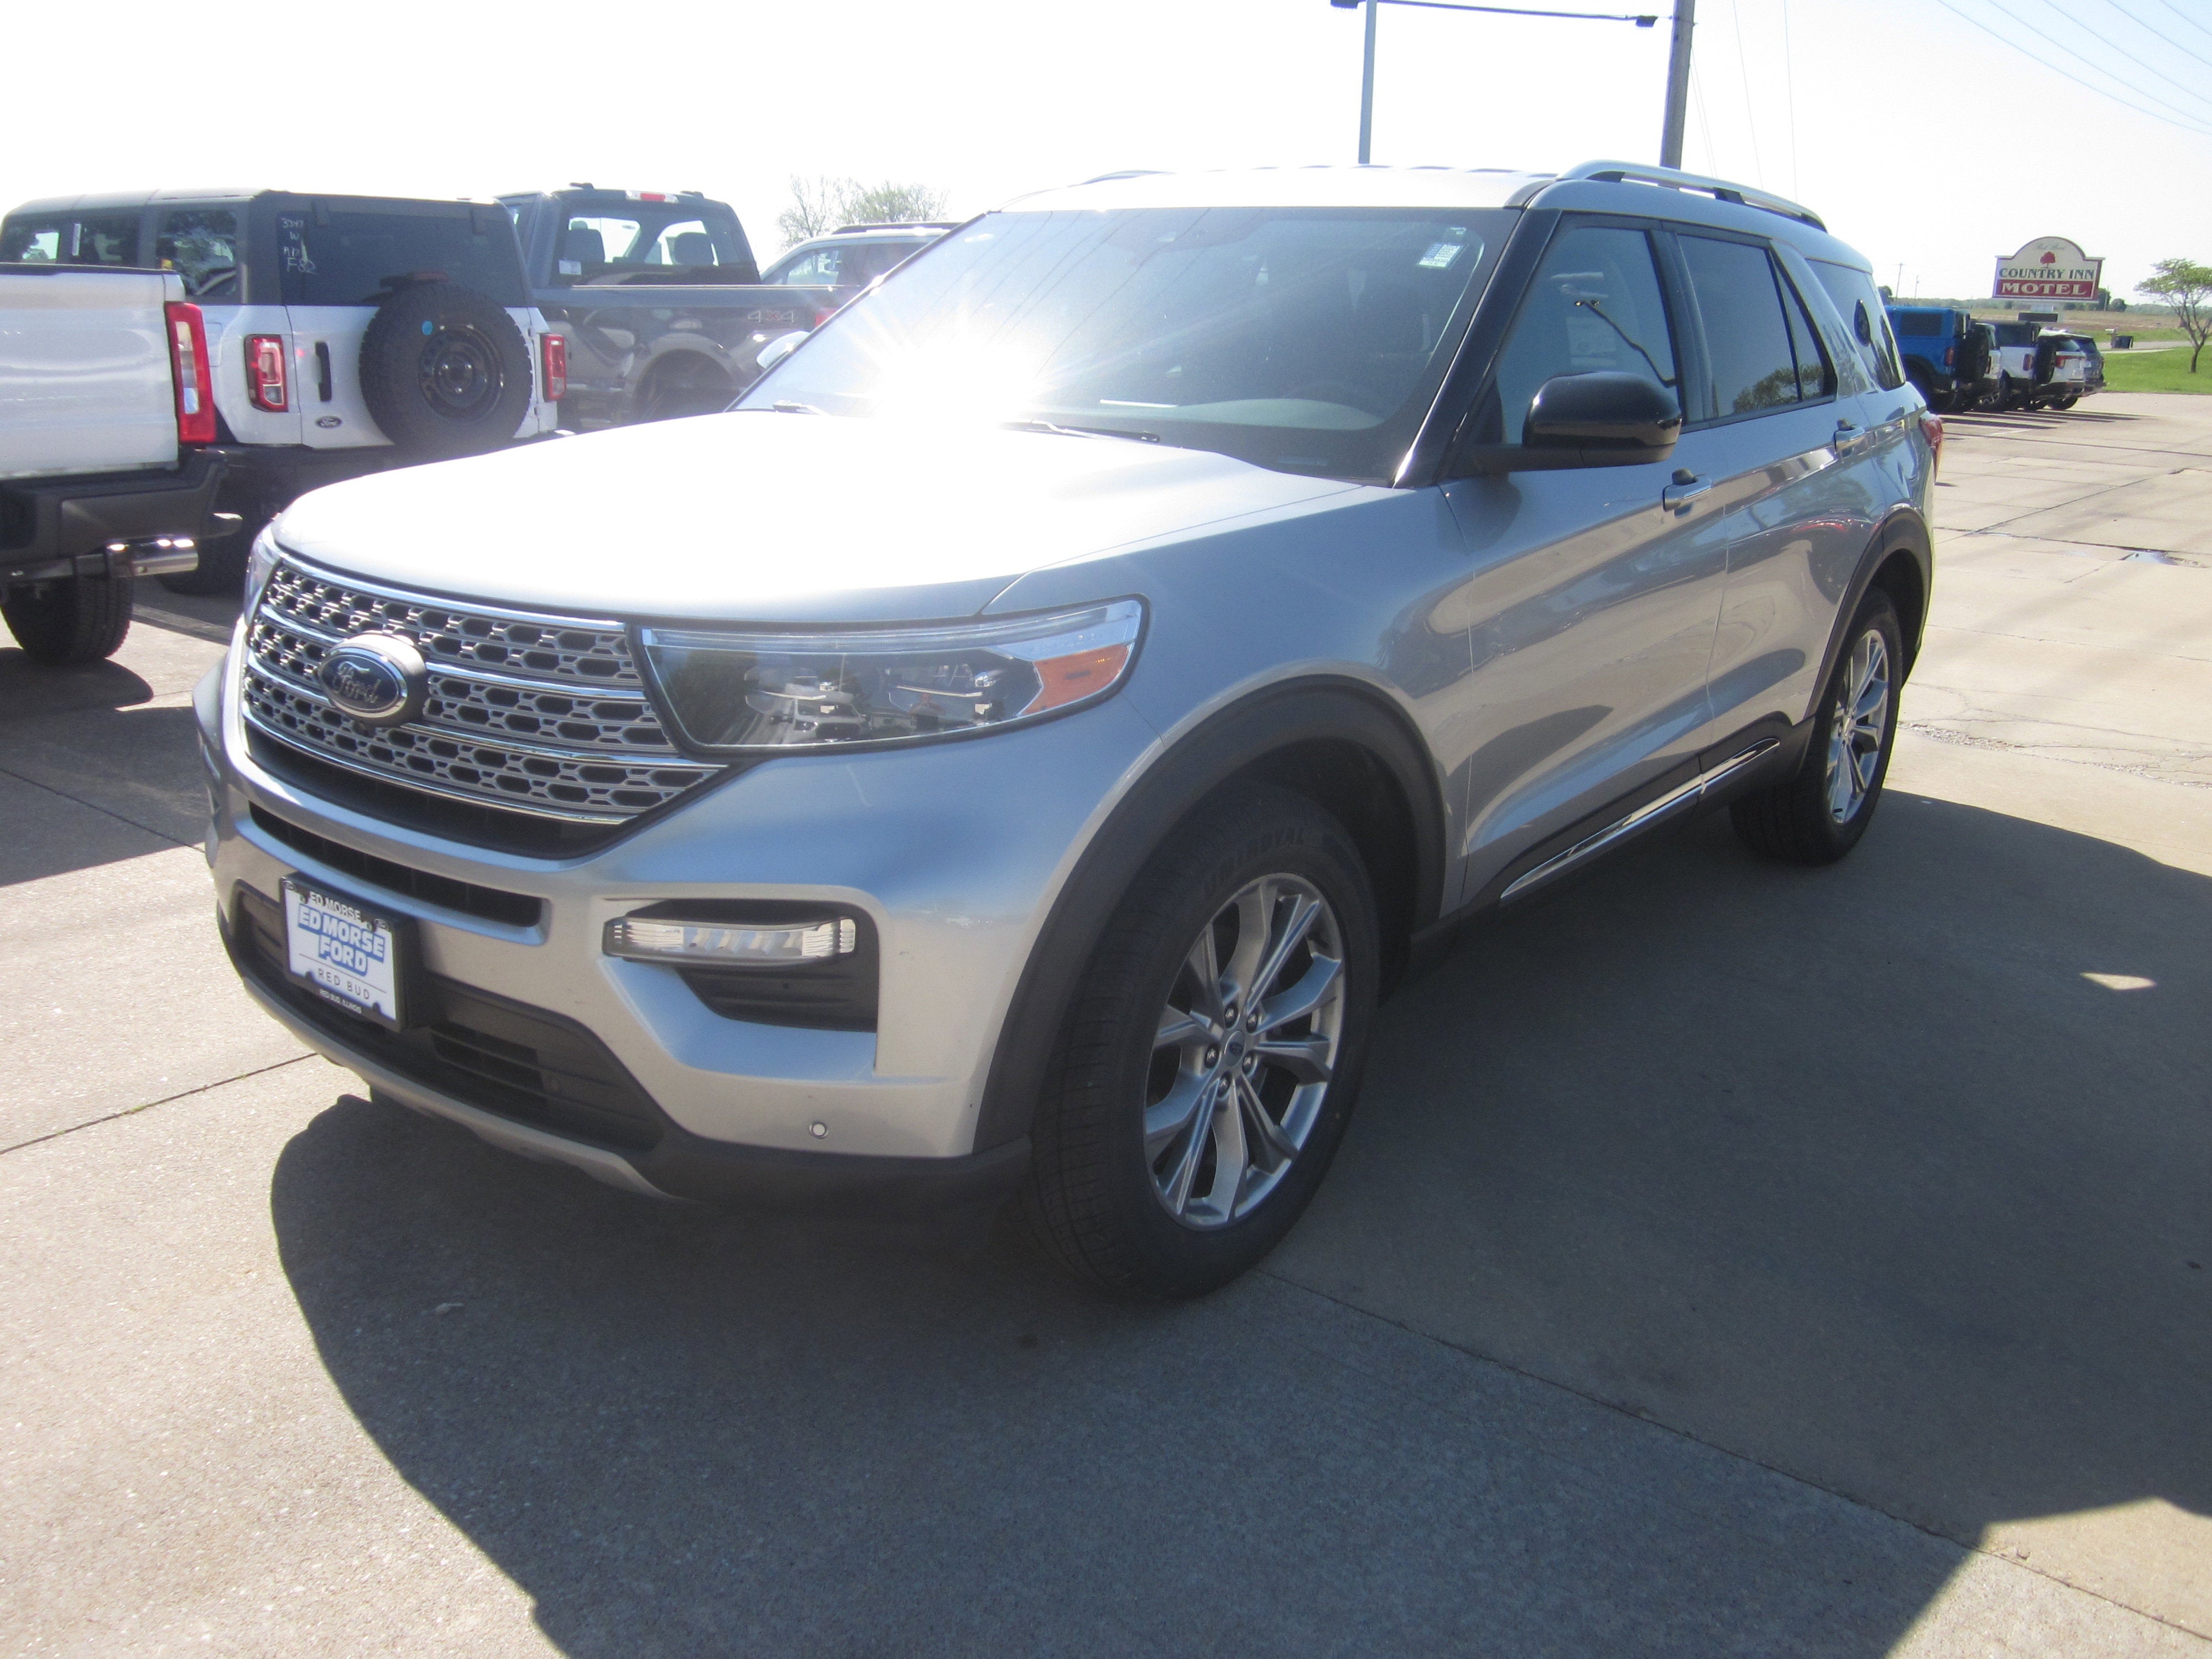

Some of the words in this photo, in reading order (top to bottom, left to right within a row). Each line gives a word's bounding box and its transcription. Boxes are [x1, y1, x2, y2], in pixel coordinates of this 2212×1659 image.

[289, 231, 300, 241] W
[1999, 268, 2065, 279] COUNTRY
[2068, 269, 2095, 279] INN
[2001, 282, 2087, 295] MOTEL
[309, 891, 324, 906] ED
[325, 896, 362, 921] MORSE
[299, 904, 322, 933] ED
[322, 912, 385, 962] MORSE
[319, 934, 368, 976] FORD
[317, 968, 341, 986] RED
[347, 981, 370, 1000] BUD
